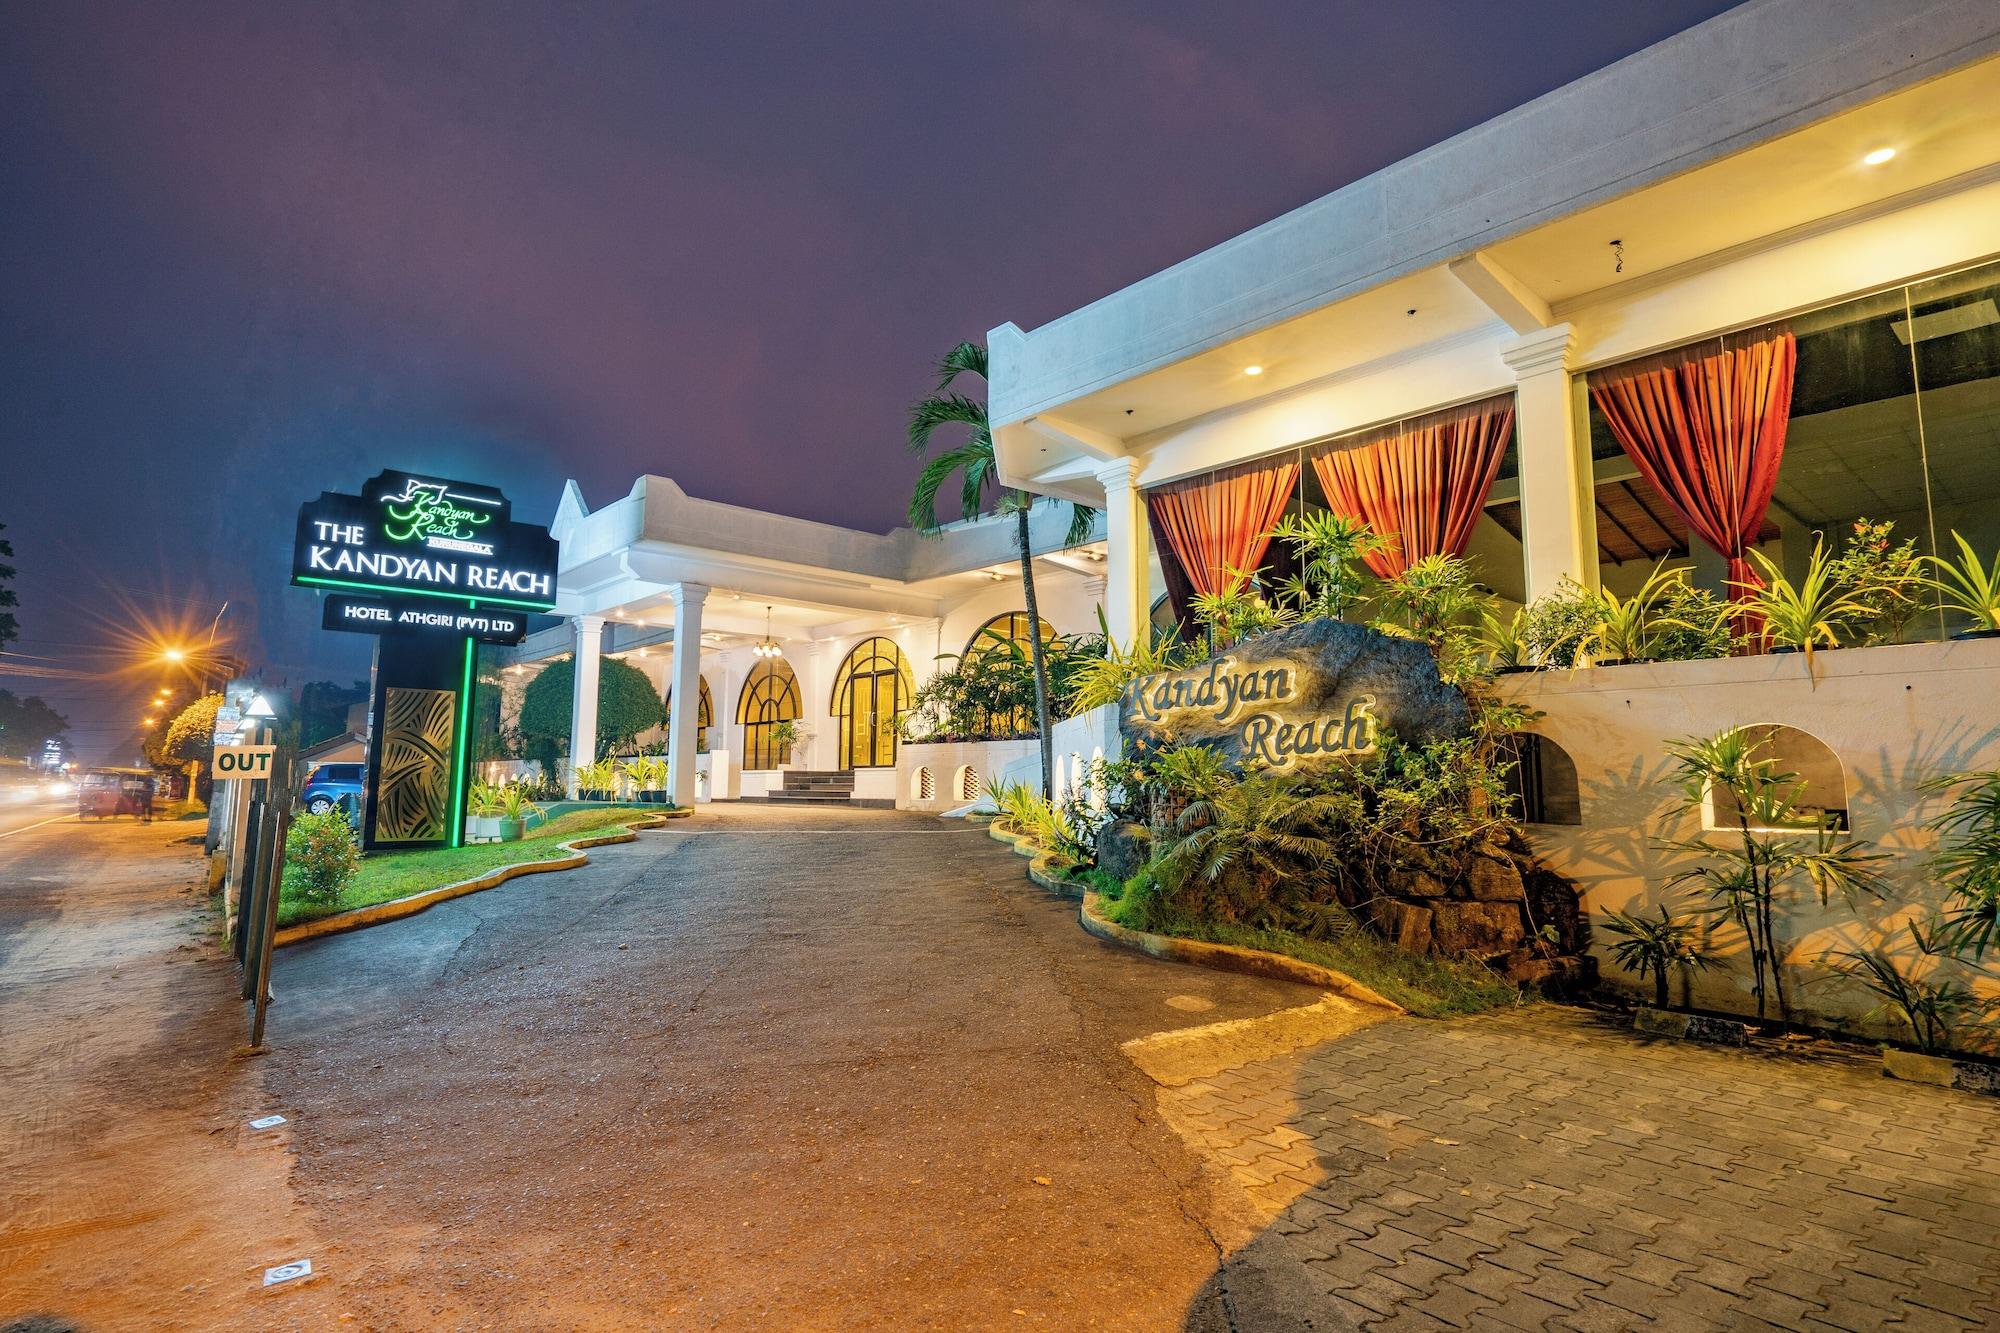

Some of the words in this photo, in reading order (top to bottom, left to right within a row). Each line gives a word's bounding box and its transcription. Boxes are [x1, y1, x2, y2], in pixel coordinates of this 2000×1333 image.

[314, 521, 364, 545] THE
[310, 545, 457, 584] KANDYAN
[467, 565, 550, 595] REACH
[344, 605, 393, 621] HOTEL
[398, 611, 453, 627] ATHGIRI
[456, 616, 489, 633] (PVT)
[491, 619, 515, 633] LTD
[1124, 656, 1297, 722] Kandyan
[1241, 694, 1377, 768] Reach
[218, 752, 271, 772] OUT
